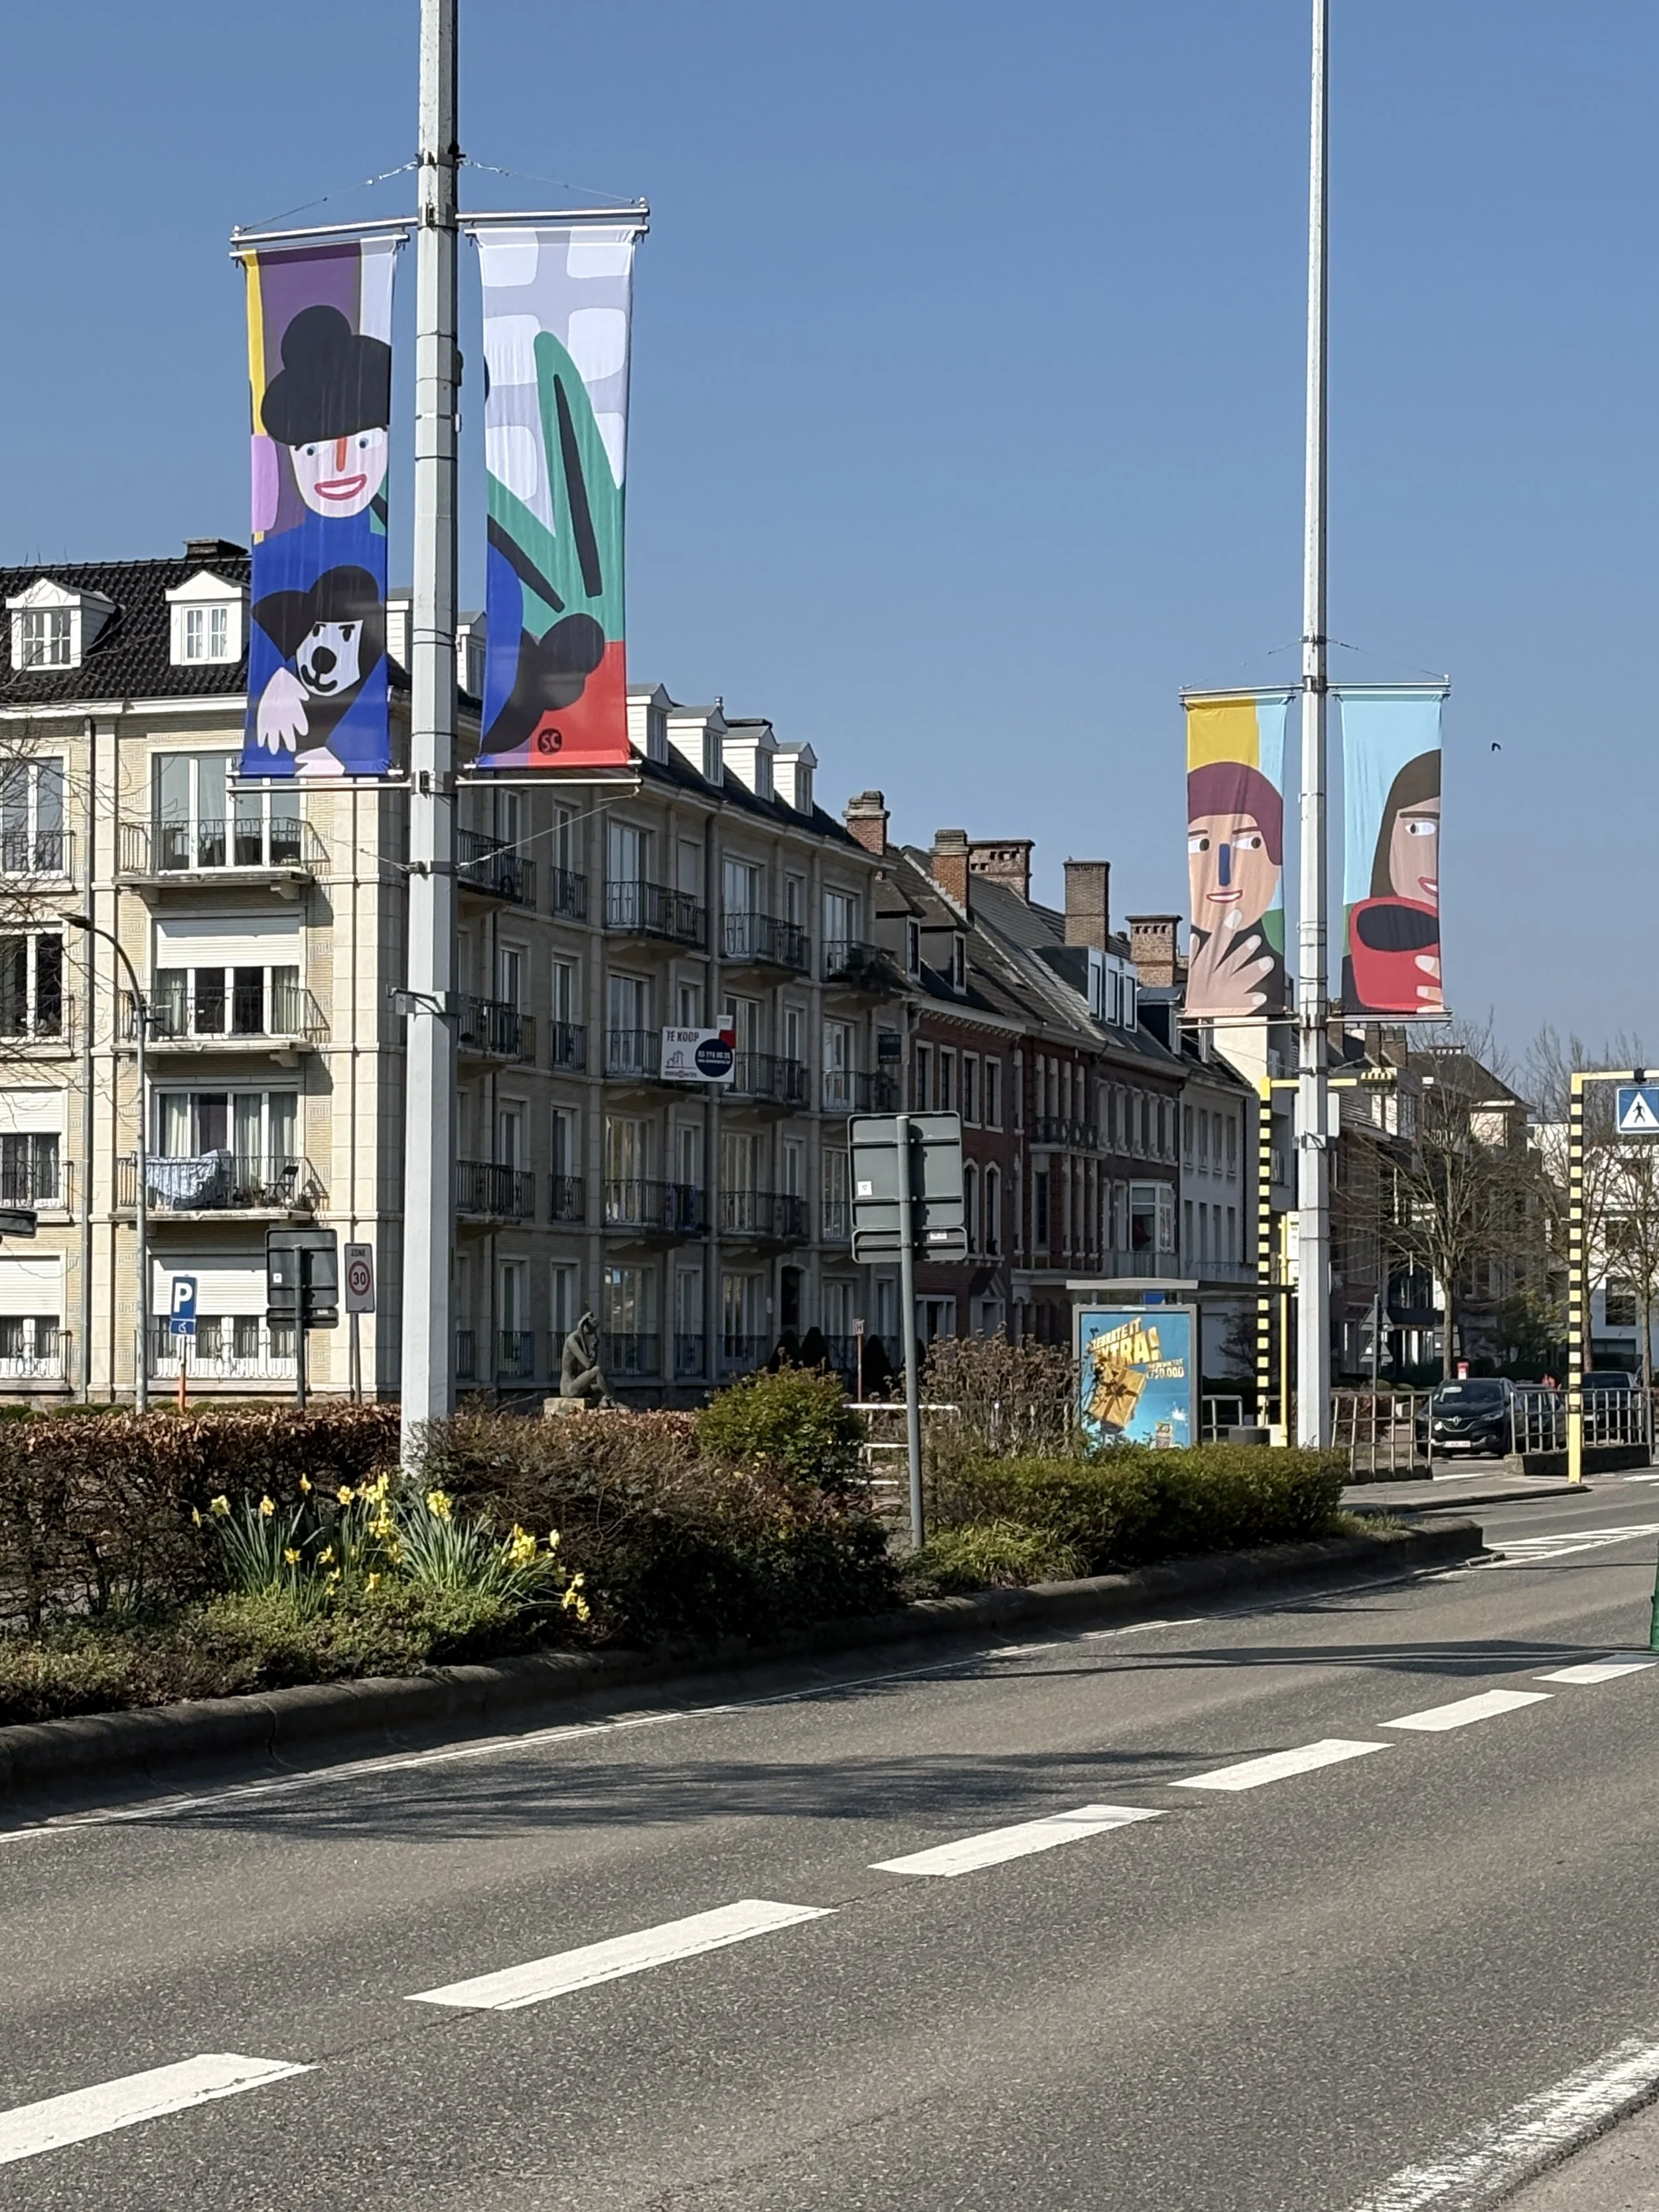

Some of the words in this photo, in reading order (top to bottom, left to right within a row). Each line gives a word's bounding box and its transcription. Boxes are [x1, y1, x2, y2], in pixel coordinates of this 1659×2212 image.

[541, 733, 559, 751] SC
[667, 1030, 675, 1041] TE
[678, 1031, 699, 1043] KOOP
[354, 1272, 366, 1286] 30
[174, 1282, 192, 1313] P
